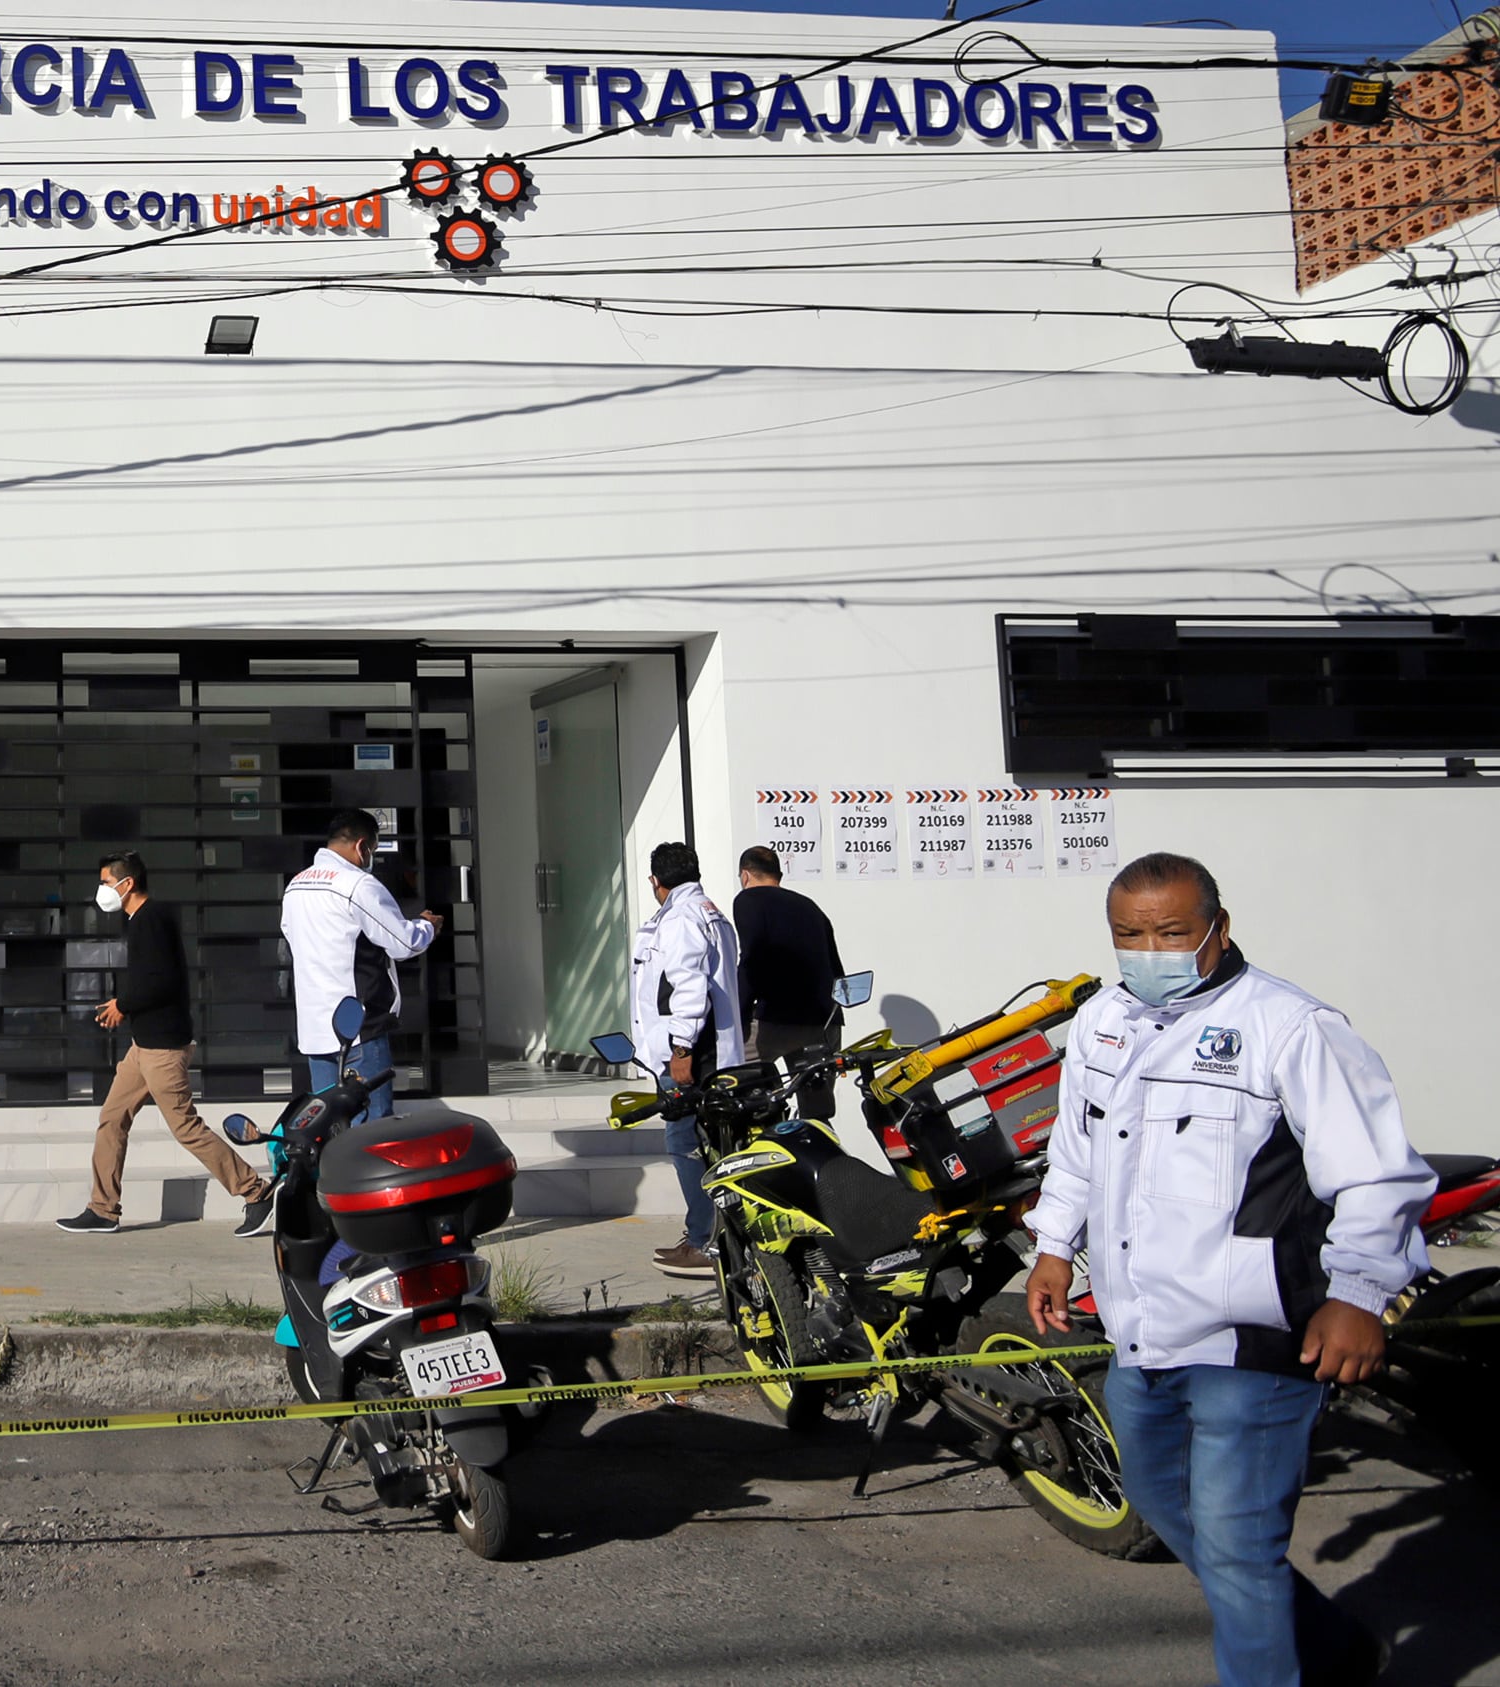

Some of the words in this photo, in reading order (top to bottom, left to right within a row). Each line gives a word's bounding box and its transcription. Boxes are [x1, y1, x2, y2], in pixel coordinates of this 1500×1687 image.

[195, 52, 297, 114] DE
[349, 58, 501, 120] LOS
[547, 66, 1158, 143] TRABAJADORES
[105, 191, 198, 222] con
[214, 186, 381, 229] unidad
[774, 816, 804, 827] 1410
[841, 817, 887, 828] 207399
[919, 815, 964, 827] 210169
[987, 814, 1032, 825] 211988
[1061, 812, 1105, 824] 213577
[769, 841, 815, 852] 207397
[845, 841, 891, 852] 210166
[921, 840, 965, 852] 211987
[987, 839, 1032, 850] 213576
[1063, 836, 1108, 848] 501060
[784, 860, 790, 874] 1
[859, 861, 868, 874] 2
[937, 861, 947, 876] 3
[1005, 859, 1014, 873] 4
[1081, 858, 1092, 871] 5
[1193, 1060, 1239, 1072] ANIVERSARIO
[417, 1348, 491, 1383] 45TEE3
[453, 1377, 483, 1388] PUEBLA
